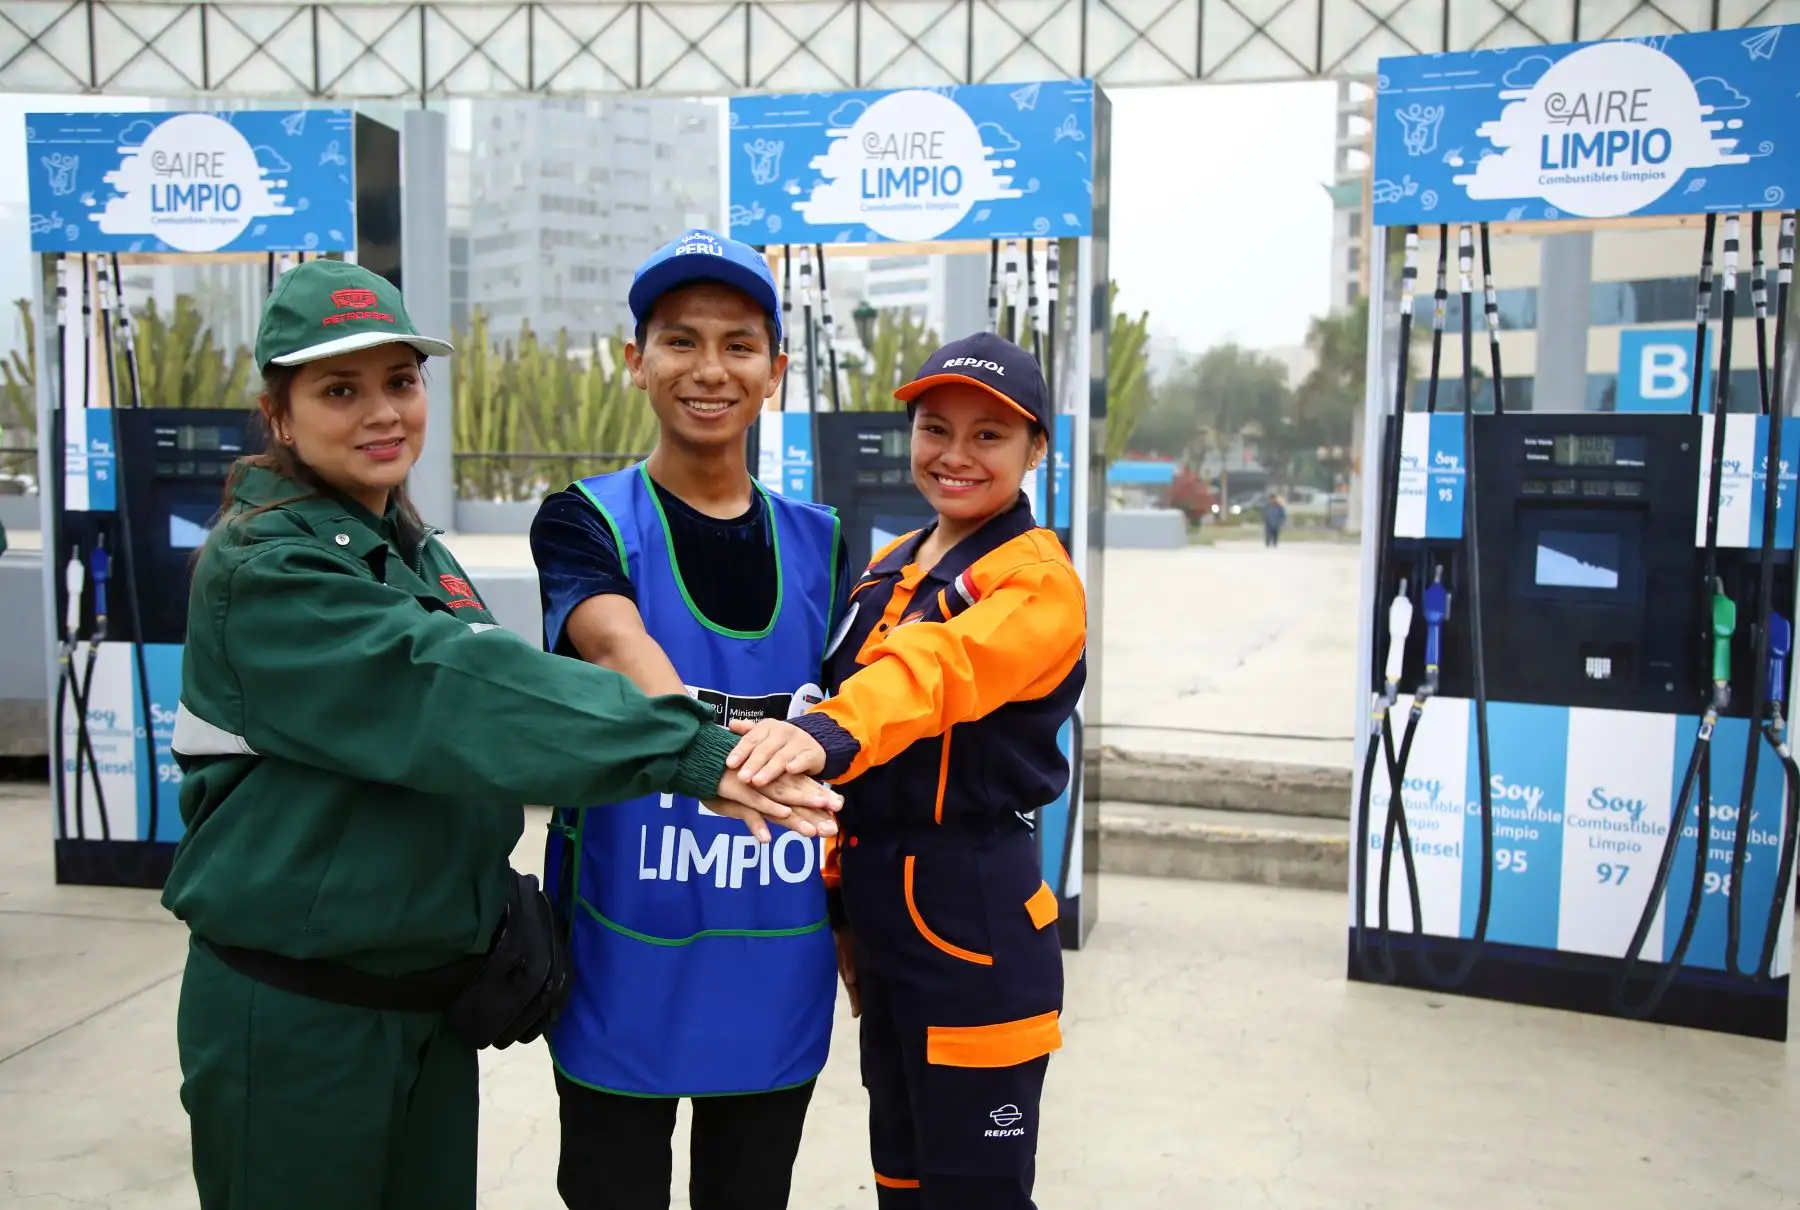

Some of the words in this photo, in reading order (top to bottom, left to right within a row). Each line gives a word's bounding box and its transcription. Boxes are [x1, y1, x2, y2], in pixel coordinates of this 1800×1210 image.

[1566, 88, 1652, 126] AIRE
[880, 130, 945, 160] AIRE
[1540, 128, 1672, 170] LIMPIO
[167, 151, 225, 178] AIRE
[861, 165, 962, 199] LIMPIO
[1538, 172, 1619, 186] Combustibles
[1621, 170, 1666, 183] limpios
[151, 183, 241, 212] LIMPIO
[675, 242, 723, 257] PERÚ
[942, 357, 1005, 376] REPSOL
[1640, 343, 1689, 400] B
[1435, 449, 1459, 469] Soy
[1722, 460, 1741, 474] oy
[1438, 487, 1453, 502] 95
[158, 764, 183, 784] 95
[1490, 774, 1545, 810] Soy
[1587, 786, 1647, 823] Soy
[1492, 822, 1540, 841] impio
[1567, 814, 1667, 837] Combustible
[639, 824, 815, 889] LIMPIO
[1588, 836, 1642, 855] Limpio
[1495, 848, 1528, 873] 95
[1596, 862, 1630, 886] 97
[983, 1127, 1025, 1137] REPSOL
